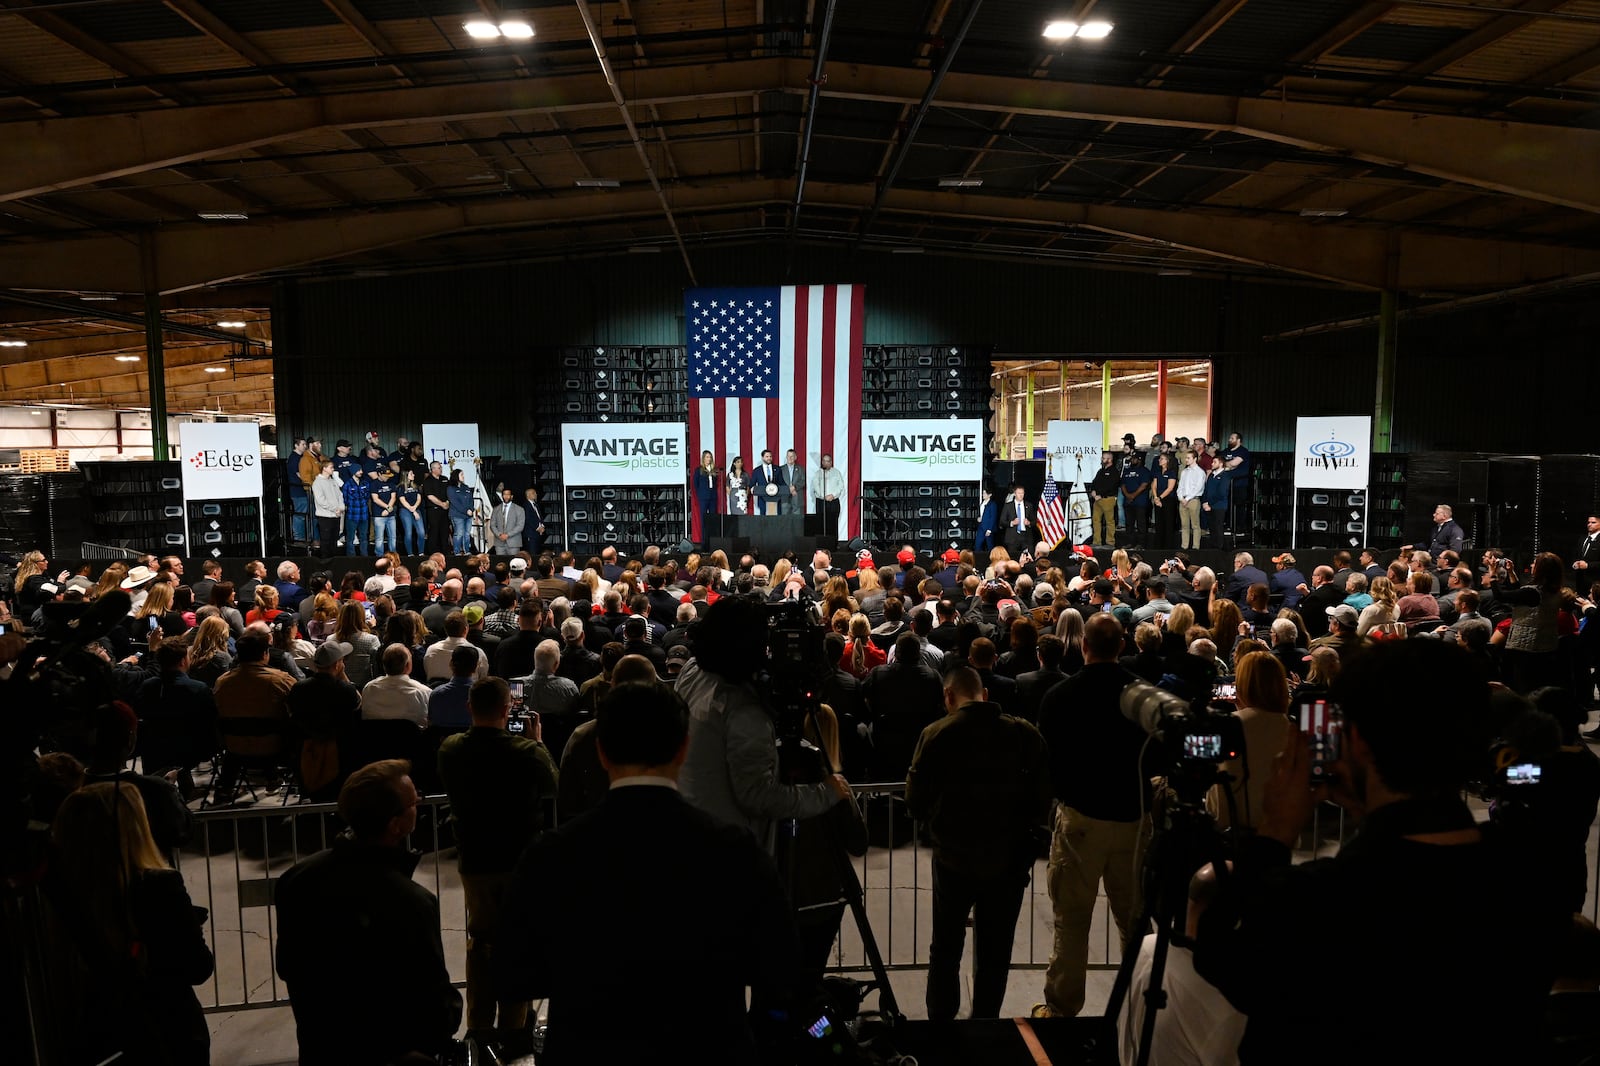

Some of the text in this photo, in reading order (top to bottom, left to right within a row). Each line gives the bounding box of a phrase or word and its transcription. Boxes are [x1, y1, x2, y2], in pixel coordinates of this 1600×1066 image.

[569, 438, 679, 457] VANTAGE
[868, 434, 976, 453] VANTAGE
[1055, 446, 1098, 455] AIRPARK
[203, 449, 254, 472] Edge
[447, 449, 475, 458] LOTIS
[929, 452, 976, 468] plastics
[631, 456, 680, 471] plastics
